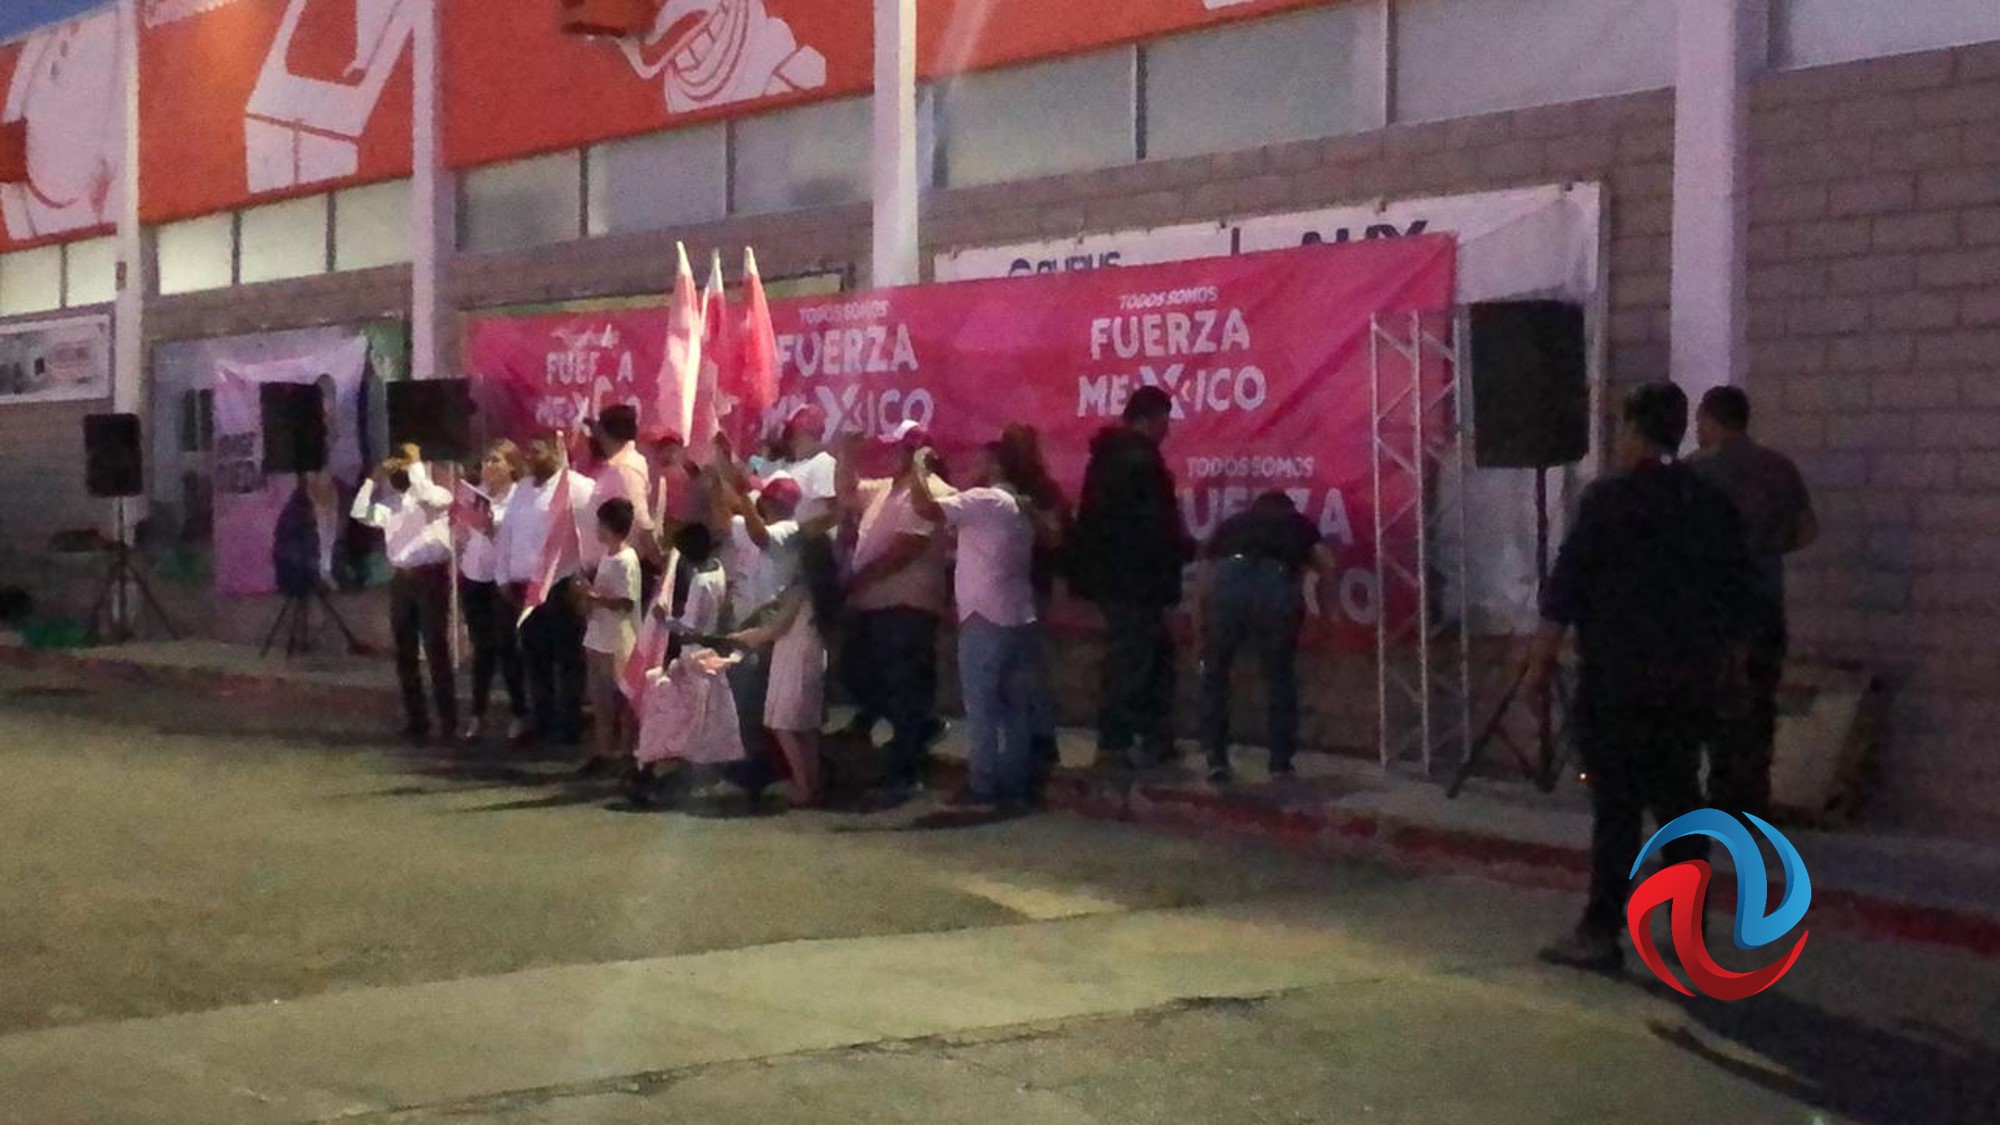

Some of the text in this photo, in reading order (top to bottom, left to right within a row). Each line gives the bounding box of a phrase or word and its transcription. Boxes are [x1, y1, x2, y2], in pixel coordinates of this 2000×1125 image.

[1120, 286, 1219, 310] TODOS SOMOS
[775, 323, 919, 379] FUERZA
[1090, 307, 1251, 361] FUERZA
[1186, 456, 1315, 478] TODOS SOMOS
